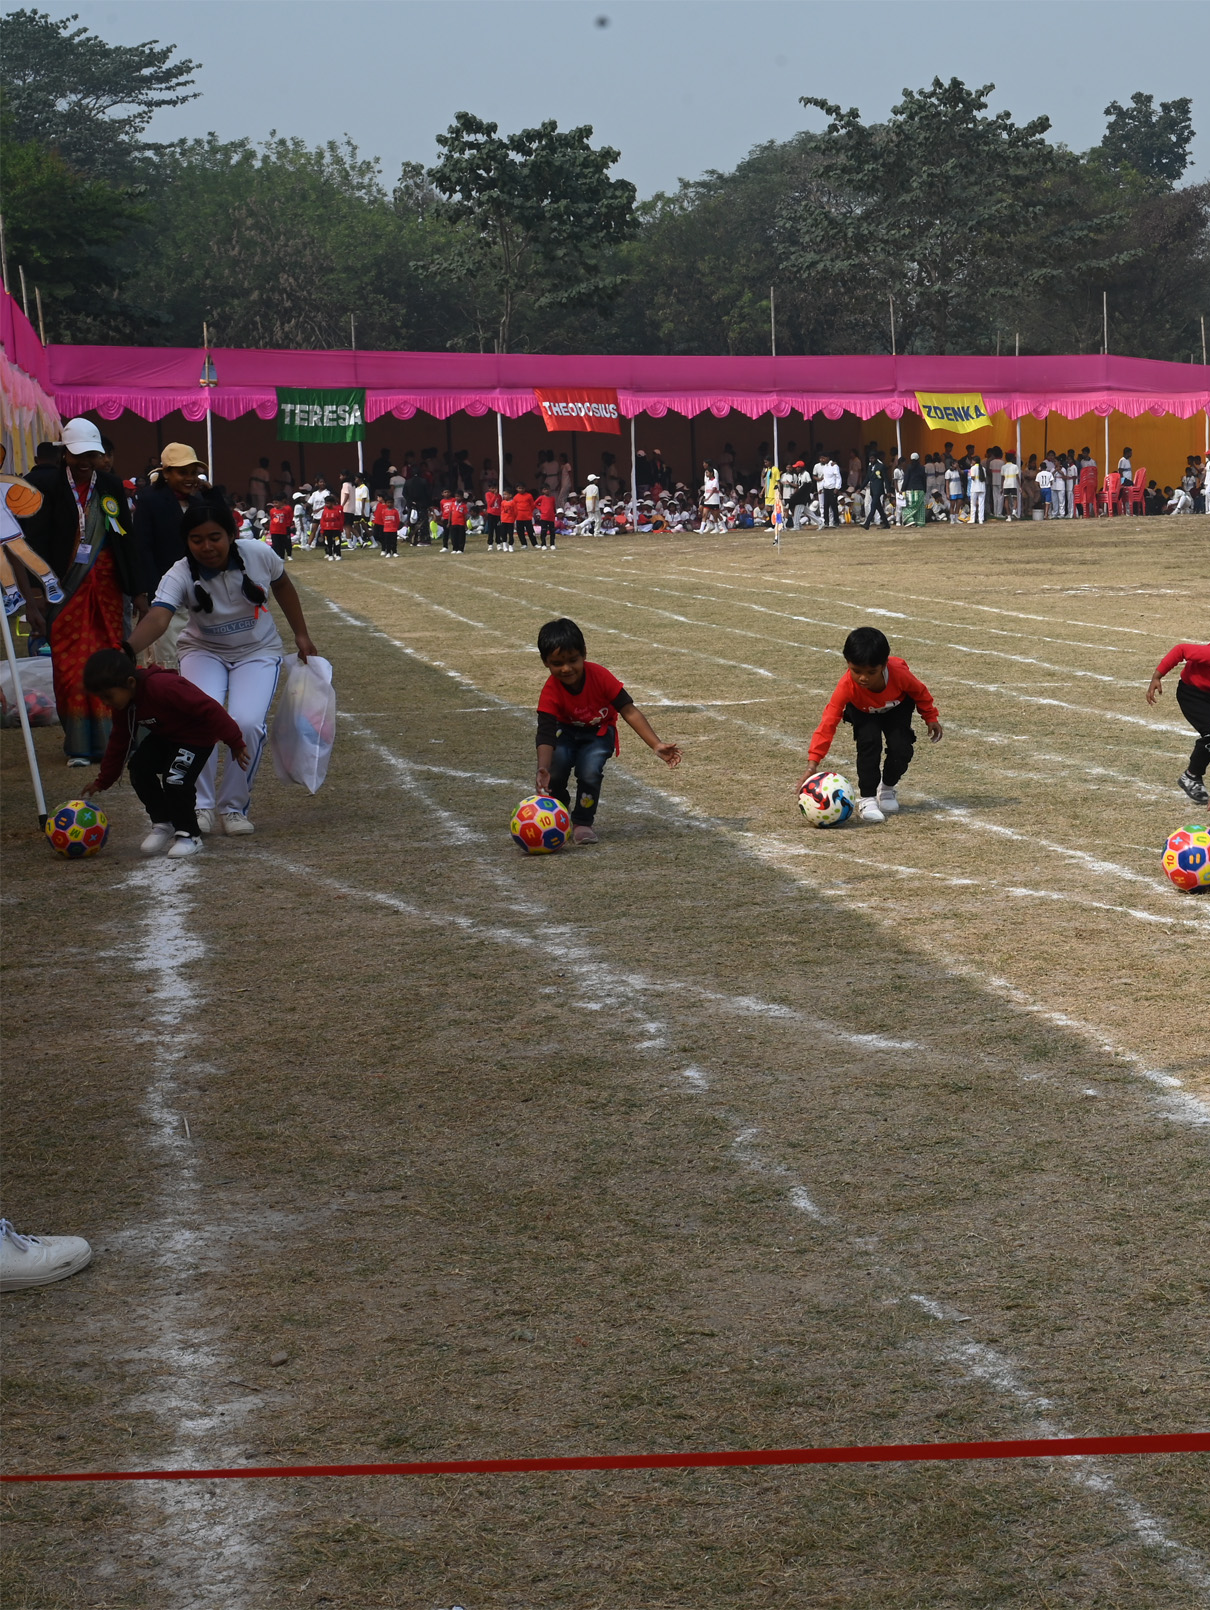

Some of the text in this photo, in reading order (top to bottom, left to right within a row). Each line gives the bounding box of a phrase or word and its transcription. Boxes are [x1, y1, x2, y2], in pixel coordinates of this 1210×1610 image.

[280, 403, 363, 427] TERESA
[542, 401, 618, 419] THEODOSIUS
[922, 404, 987, 422] ZDENKA
[212, 624, 237, 635] HOLY
[165, 747, 196, 785] RUN
[540, 815, 552, 827] 10
